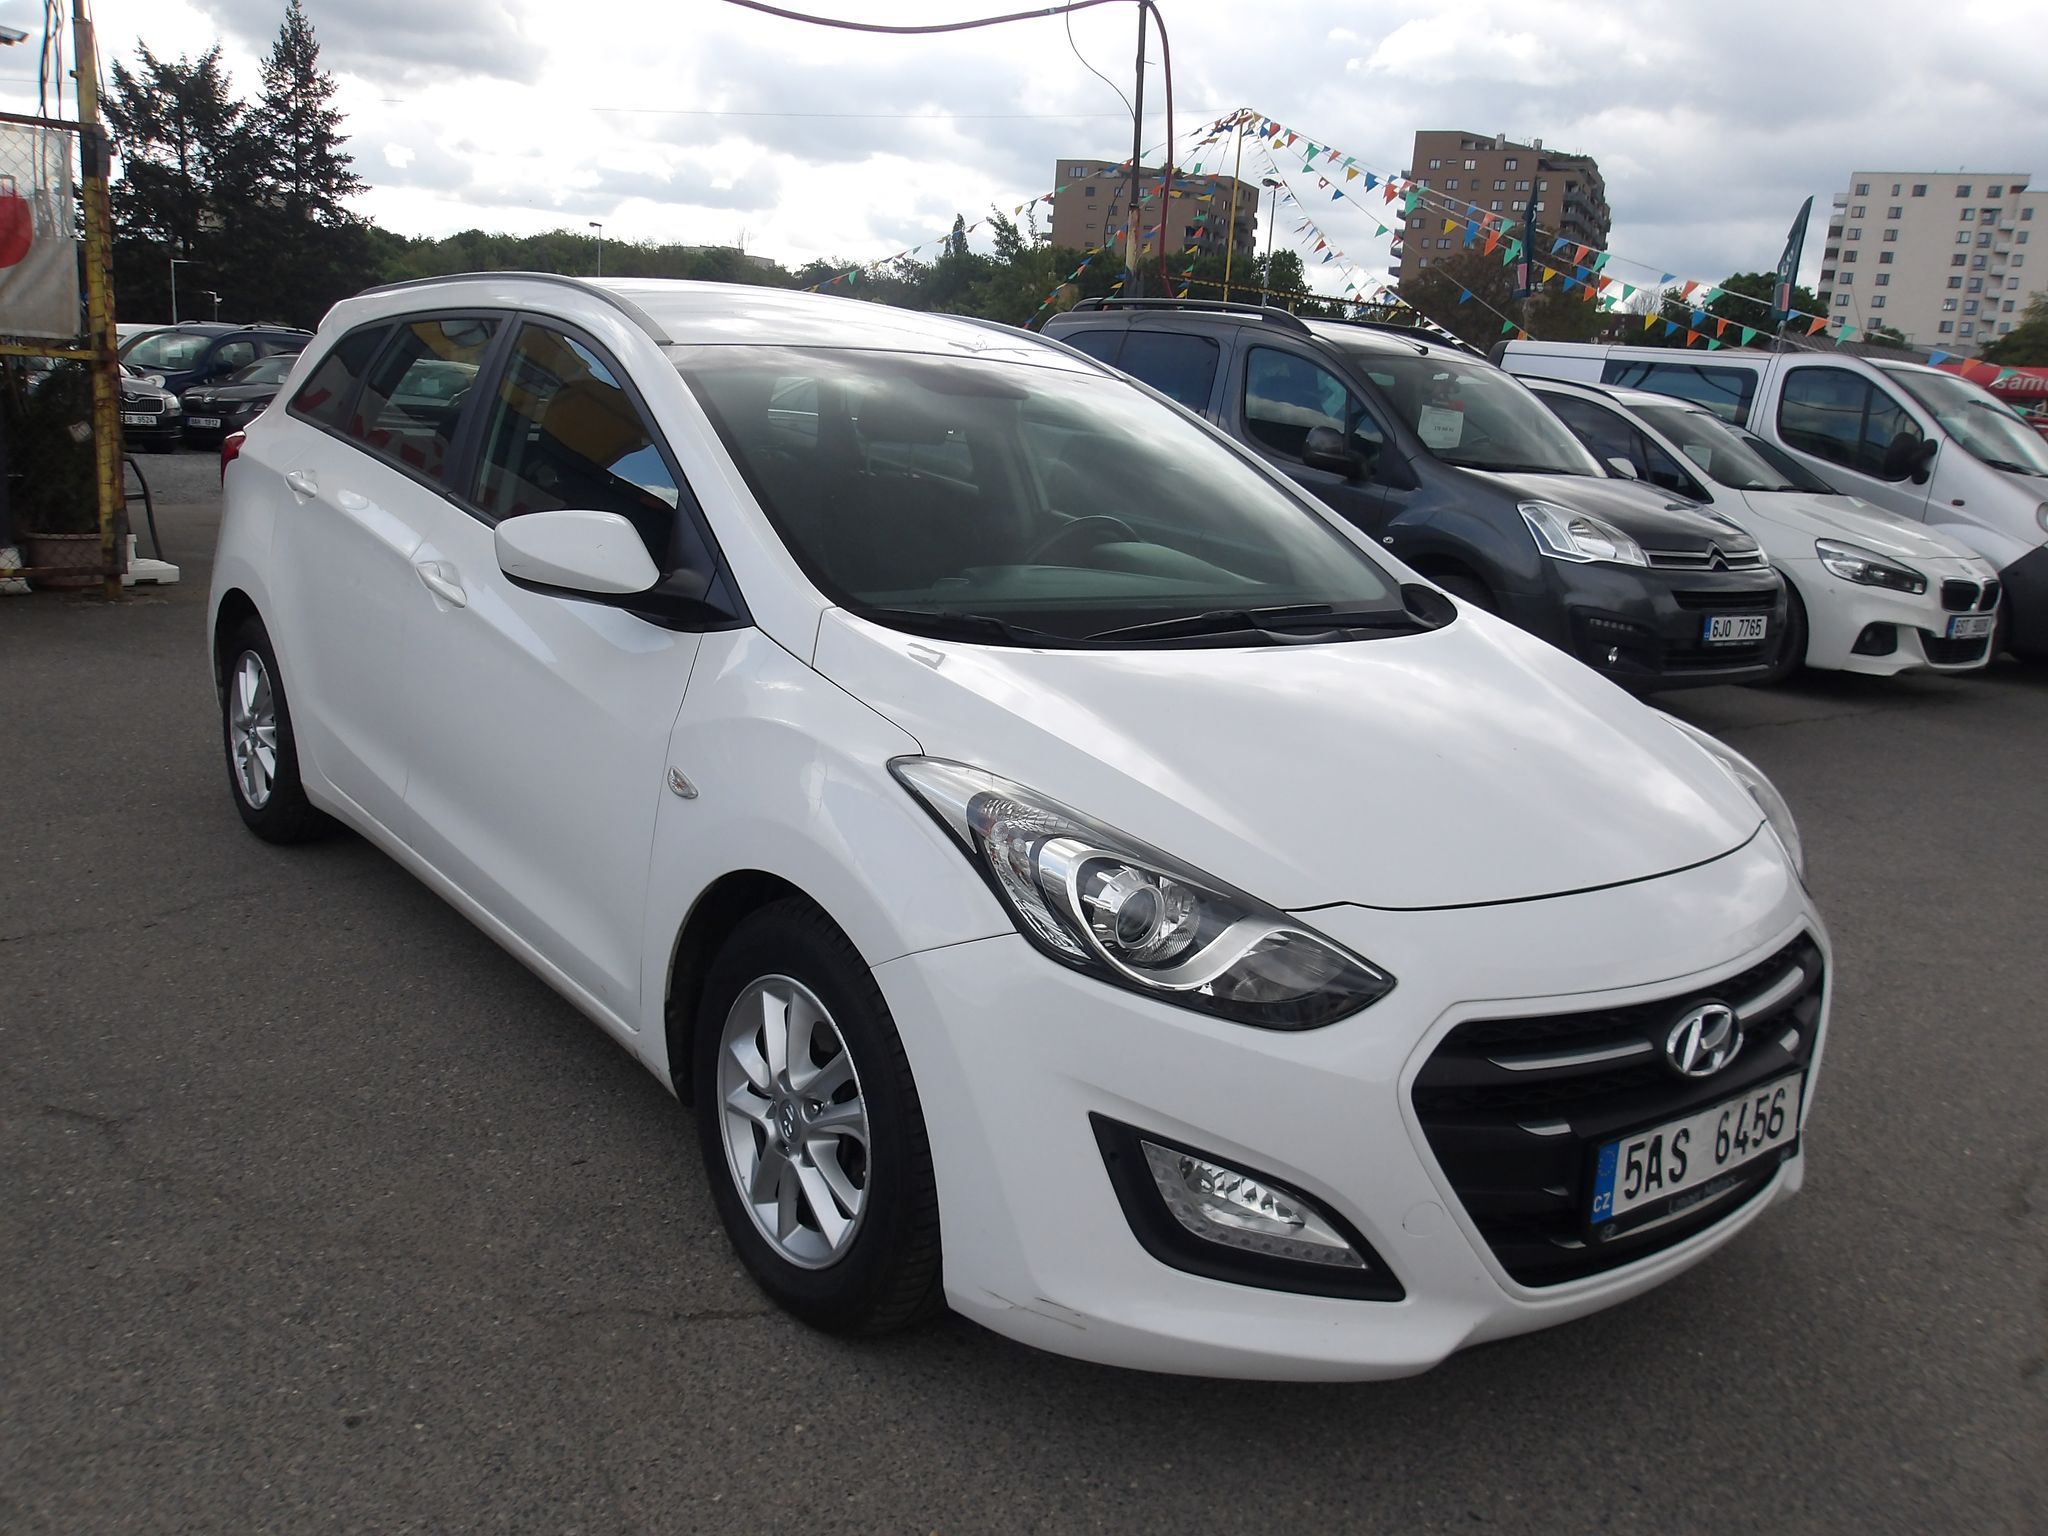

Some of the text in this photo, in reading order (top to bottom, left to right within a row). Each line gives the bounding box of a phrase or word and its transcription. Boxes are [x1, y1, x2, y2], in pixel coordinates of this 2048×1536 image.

[1737, 618, 1762, 638] 7765
[1624, 1127, 1690, 1200] 5AS
[1715, 1087, 1786, 1166] 6456
[1593, 1191, 1611, 1213] CZ
